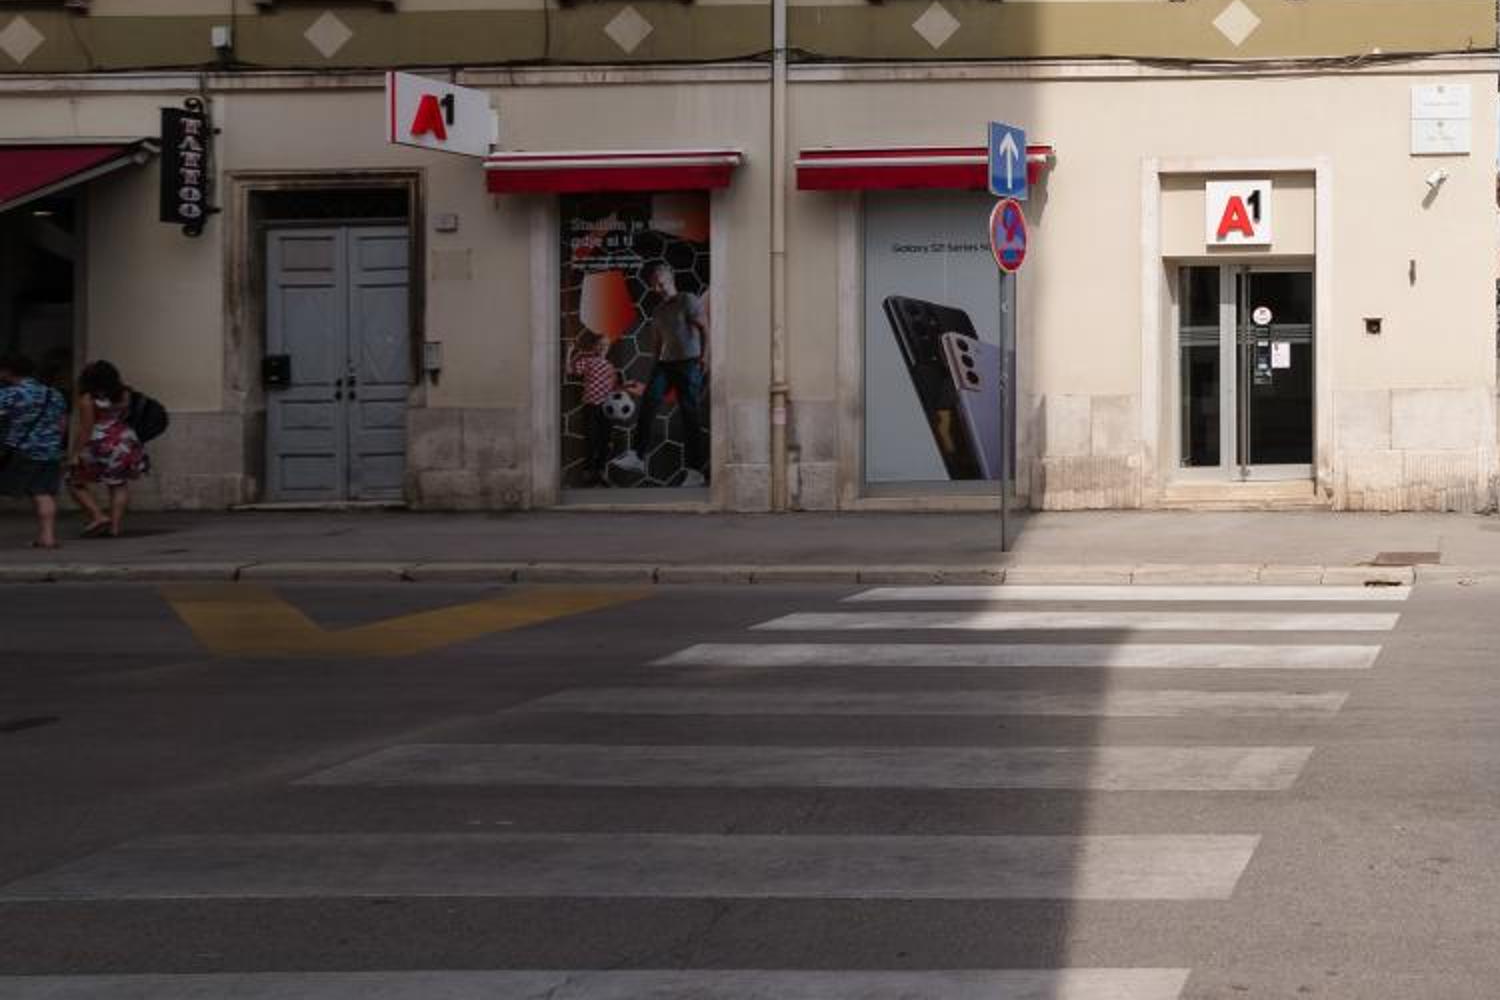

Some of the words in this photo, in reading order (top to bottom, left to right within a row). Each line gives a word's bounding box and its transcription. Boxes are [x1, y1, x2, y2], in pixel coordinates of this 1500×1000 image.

[411, 93, 455, 141] A1
[177, 117, 203, 218] TATTOO
[1216, 189, 1261, 239] A1
